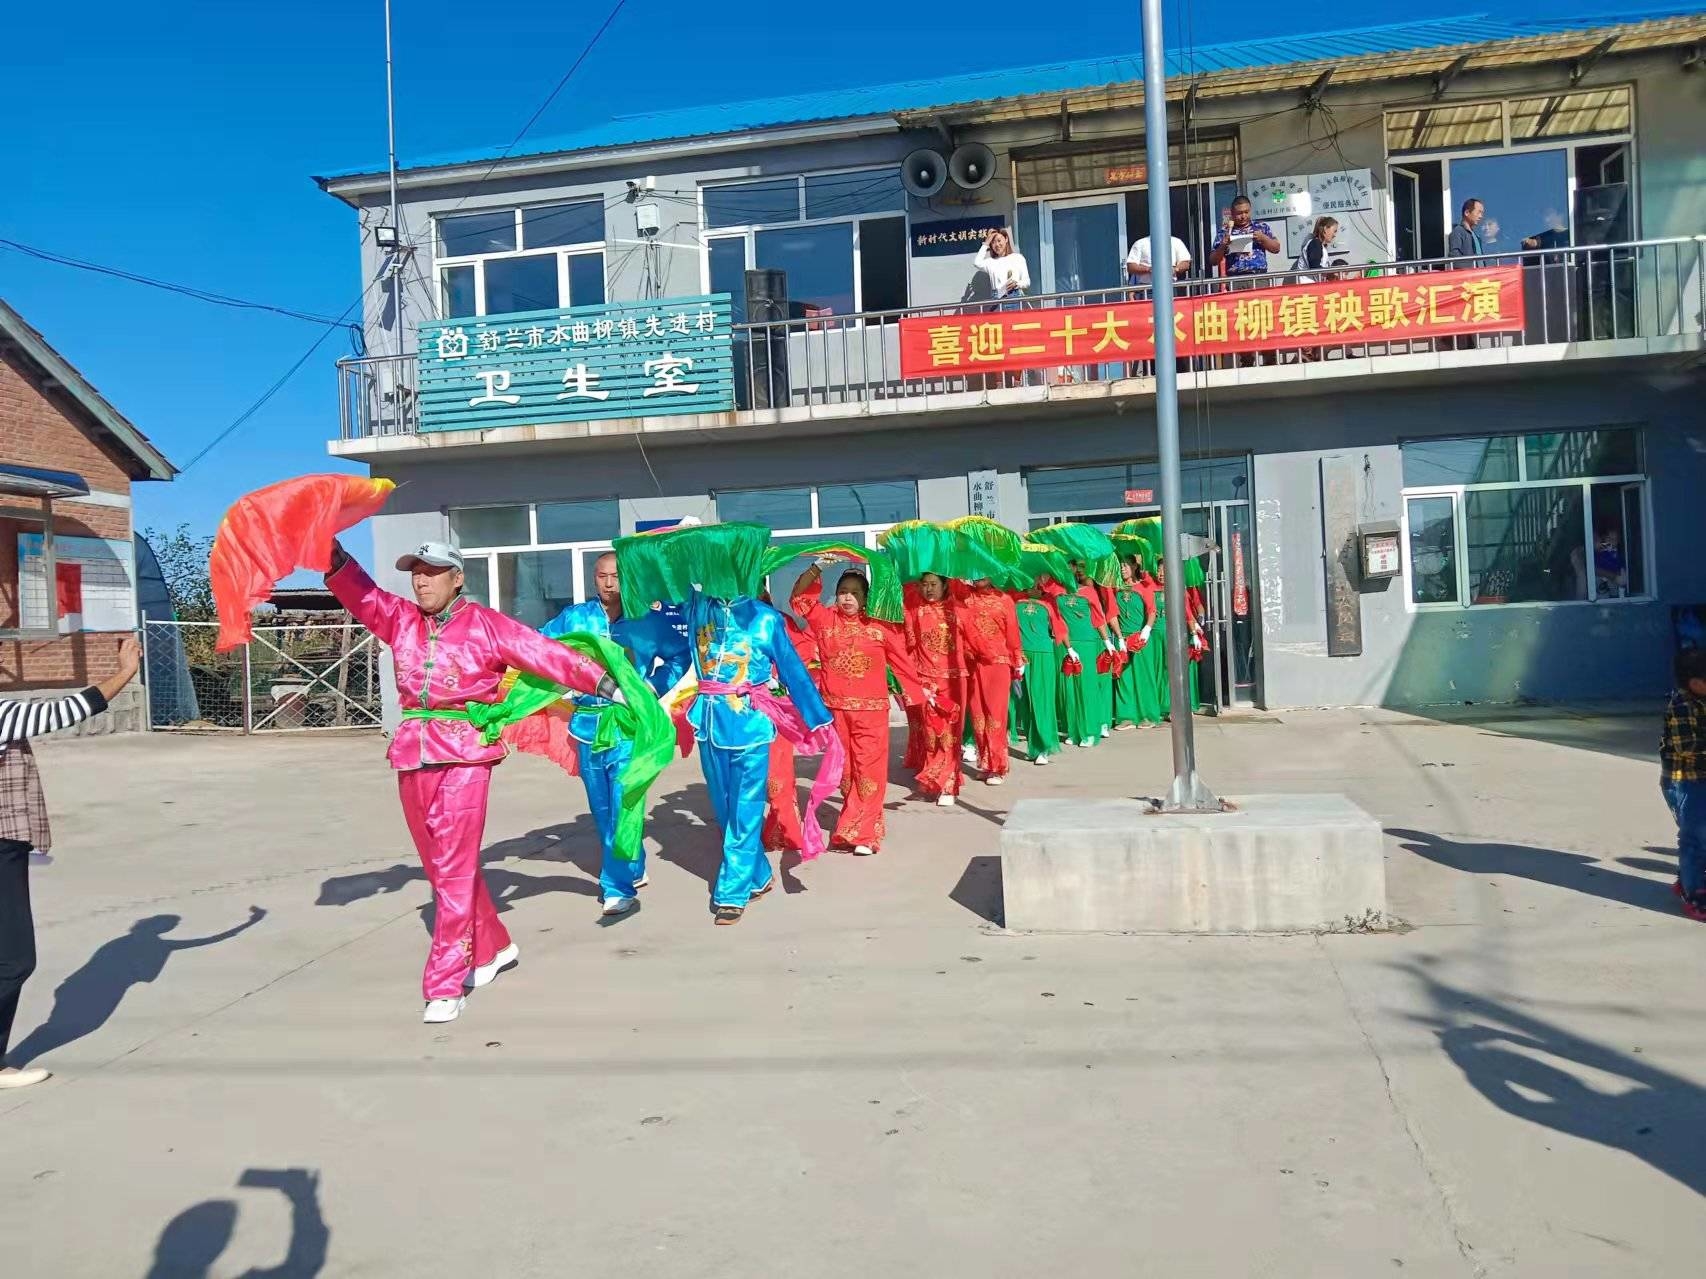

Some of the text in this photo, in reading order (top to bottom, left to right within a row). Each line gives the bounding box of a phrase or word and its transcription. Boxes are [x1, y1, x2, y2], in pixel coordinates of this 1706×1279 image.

[479, 309, 718, 351] 舒兰市水曲柳镇先进村
[927, 310, 1131, 367] 喜迎二十大
[468, 352, 700, 407] 卫生室
